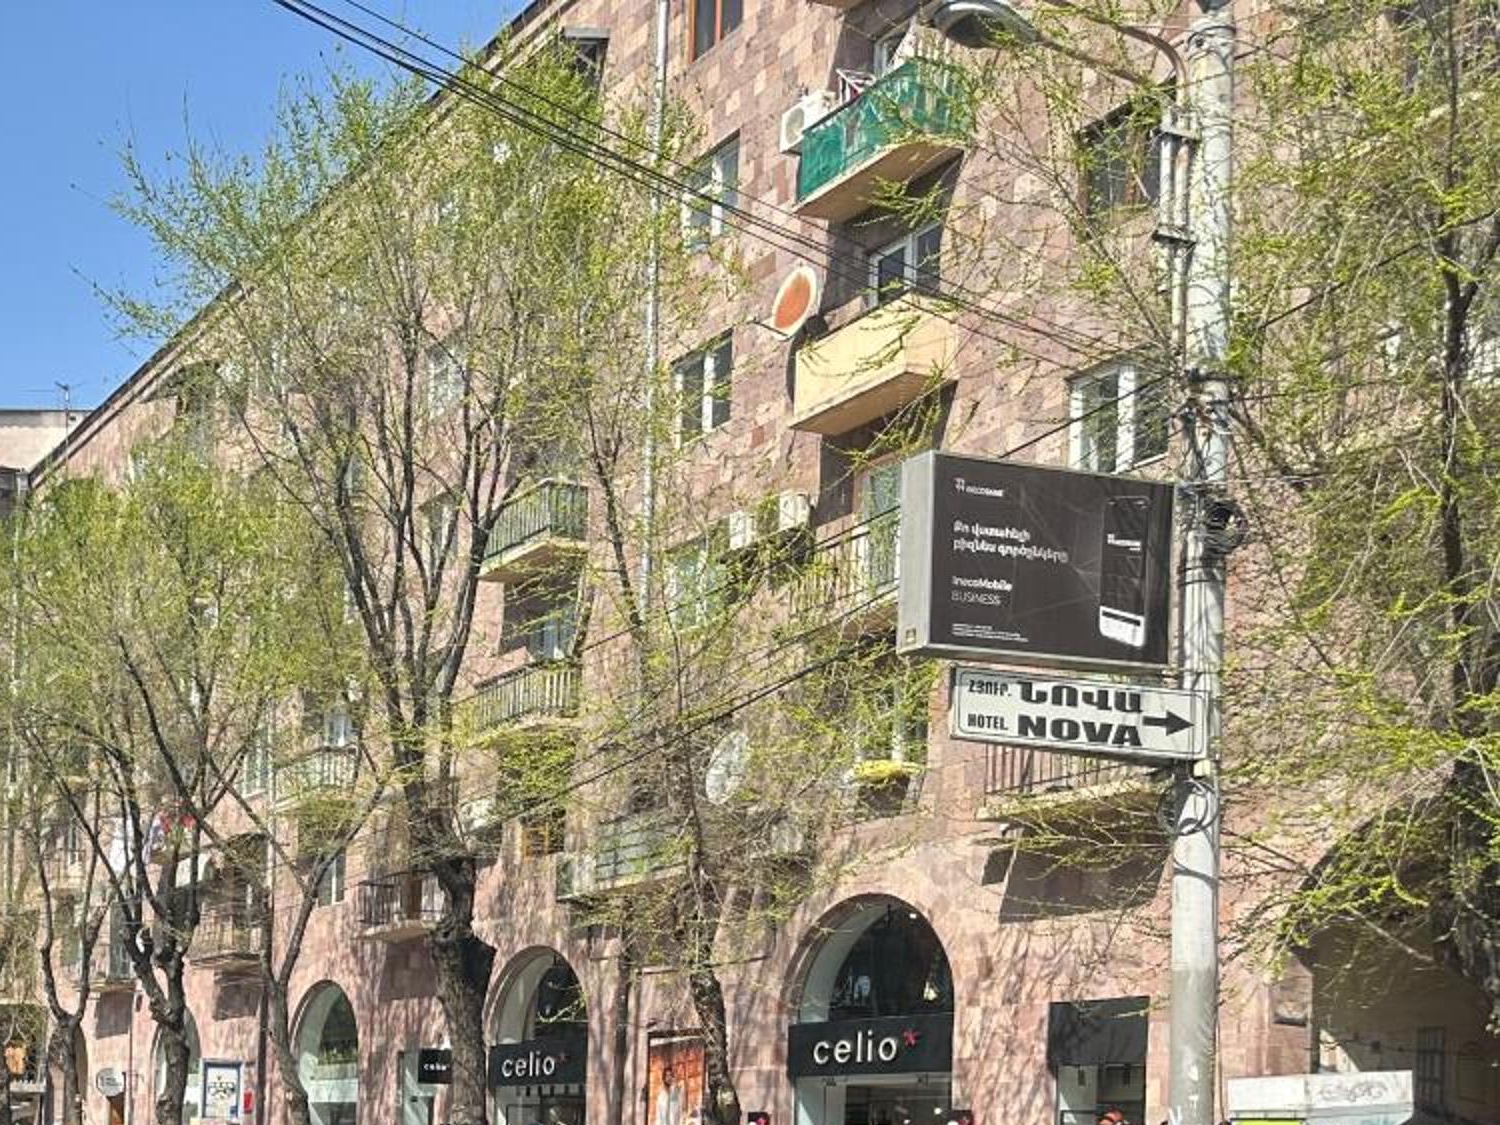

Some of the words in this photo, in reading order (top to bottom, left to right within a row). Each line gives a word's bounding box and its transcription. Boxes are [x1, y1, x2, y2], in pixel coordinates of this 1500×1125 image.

[951, 589, 1001, 606] BUSINESS
[1017, 680, 1143, 713] ՆՈՎԱ
[1017, 713, 1143, 747] NOVA
[813, 1029, 898, 1065] celio
[501, 1051, 556, 1077] celio
